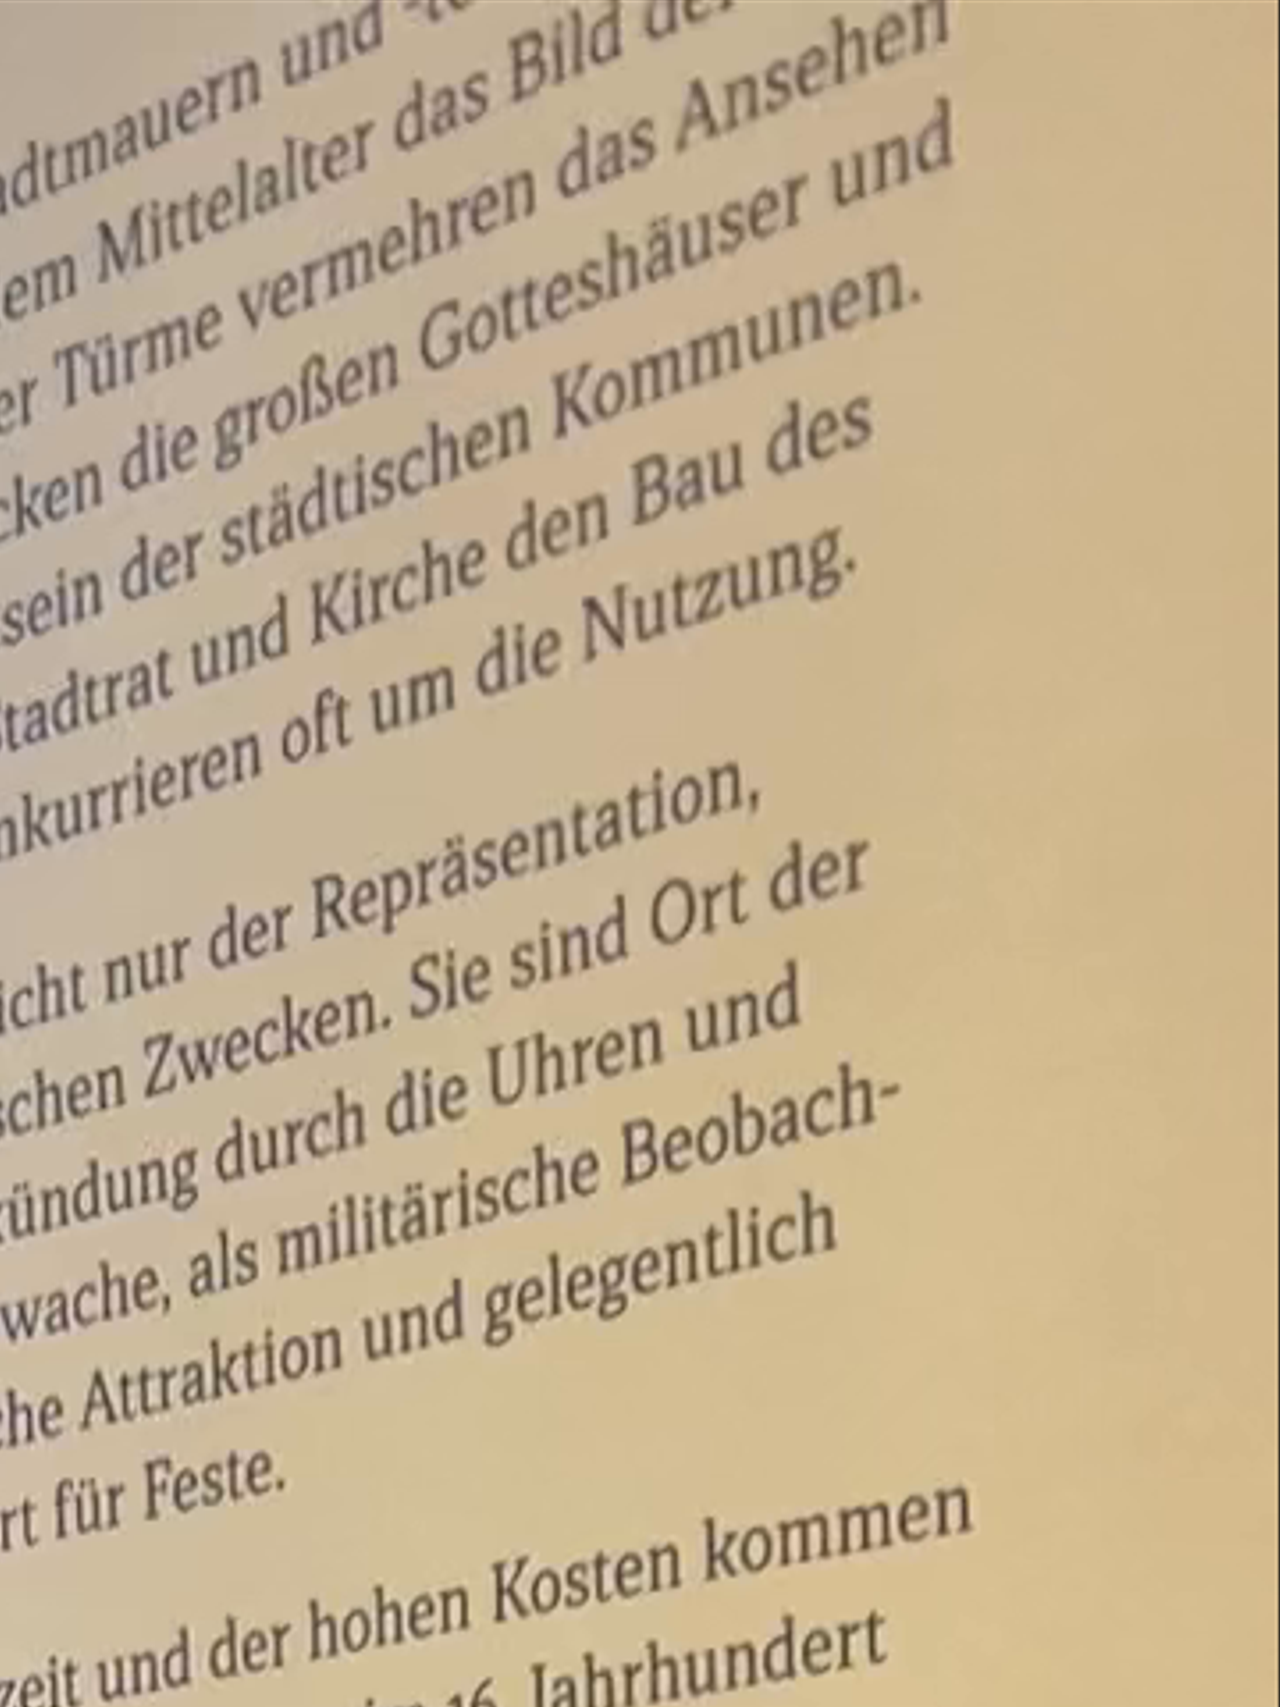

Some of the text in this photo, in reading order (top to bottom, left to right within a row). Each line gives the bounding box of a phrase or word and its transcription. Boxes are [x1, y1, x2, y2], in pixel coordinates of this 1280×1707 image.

[281, 0, 382, 86] und
[53, 304, 222, 407] Türme
[238, 170, 535, 329] vermehren
[557, 118, 656, 198] das
[676, 0, 948, 152] Ansehen
[120, 424, 198, 492] die
[215, 343, 398, 472] großen
[420, 175, 807, 370] Gotteshäuser
[832, 97, 952, 207] und
[121, 532, 203, 601] der
[222, 406, 530, 566] städtischen
[553, 263, 920, 439] Kommunen.
[104, 937, 191, 1003] nur
[209, 904, 292, 970] der
[312, 762, 759, 939] Repräsentation,
[189, 1228, 258, 1298] als
[276, 1143, 599, 1276] militärische
[621, 1062, 899, 1186] Beobach-
[215, 1087, 366, 1183] durch
[385, 1068, 468, 1137] die
[487, 1019, 663, 1106] Uhren
[685, 959, 800, 1052] und
[79, 1327, 342, 1431] Attraktion
[362, 1278, 464, 1361] und
[484, 1189, 836, 1347] gelegentlich
[54, 1478, 125, 1539] für
[144, 1451, 285, 1521] Feste.
